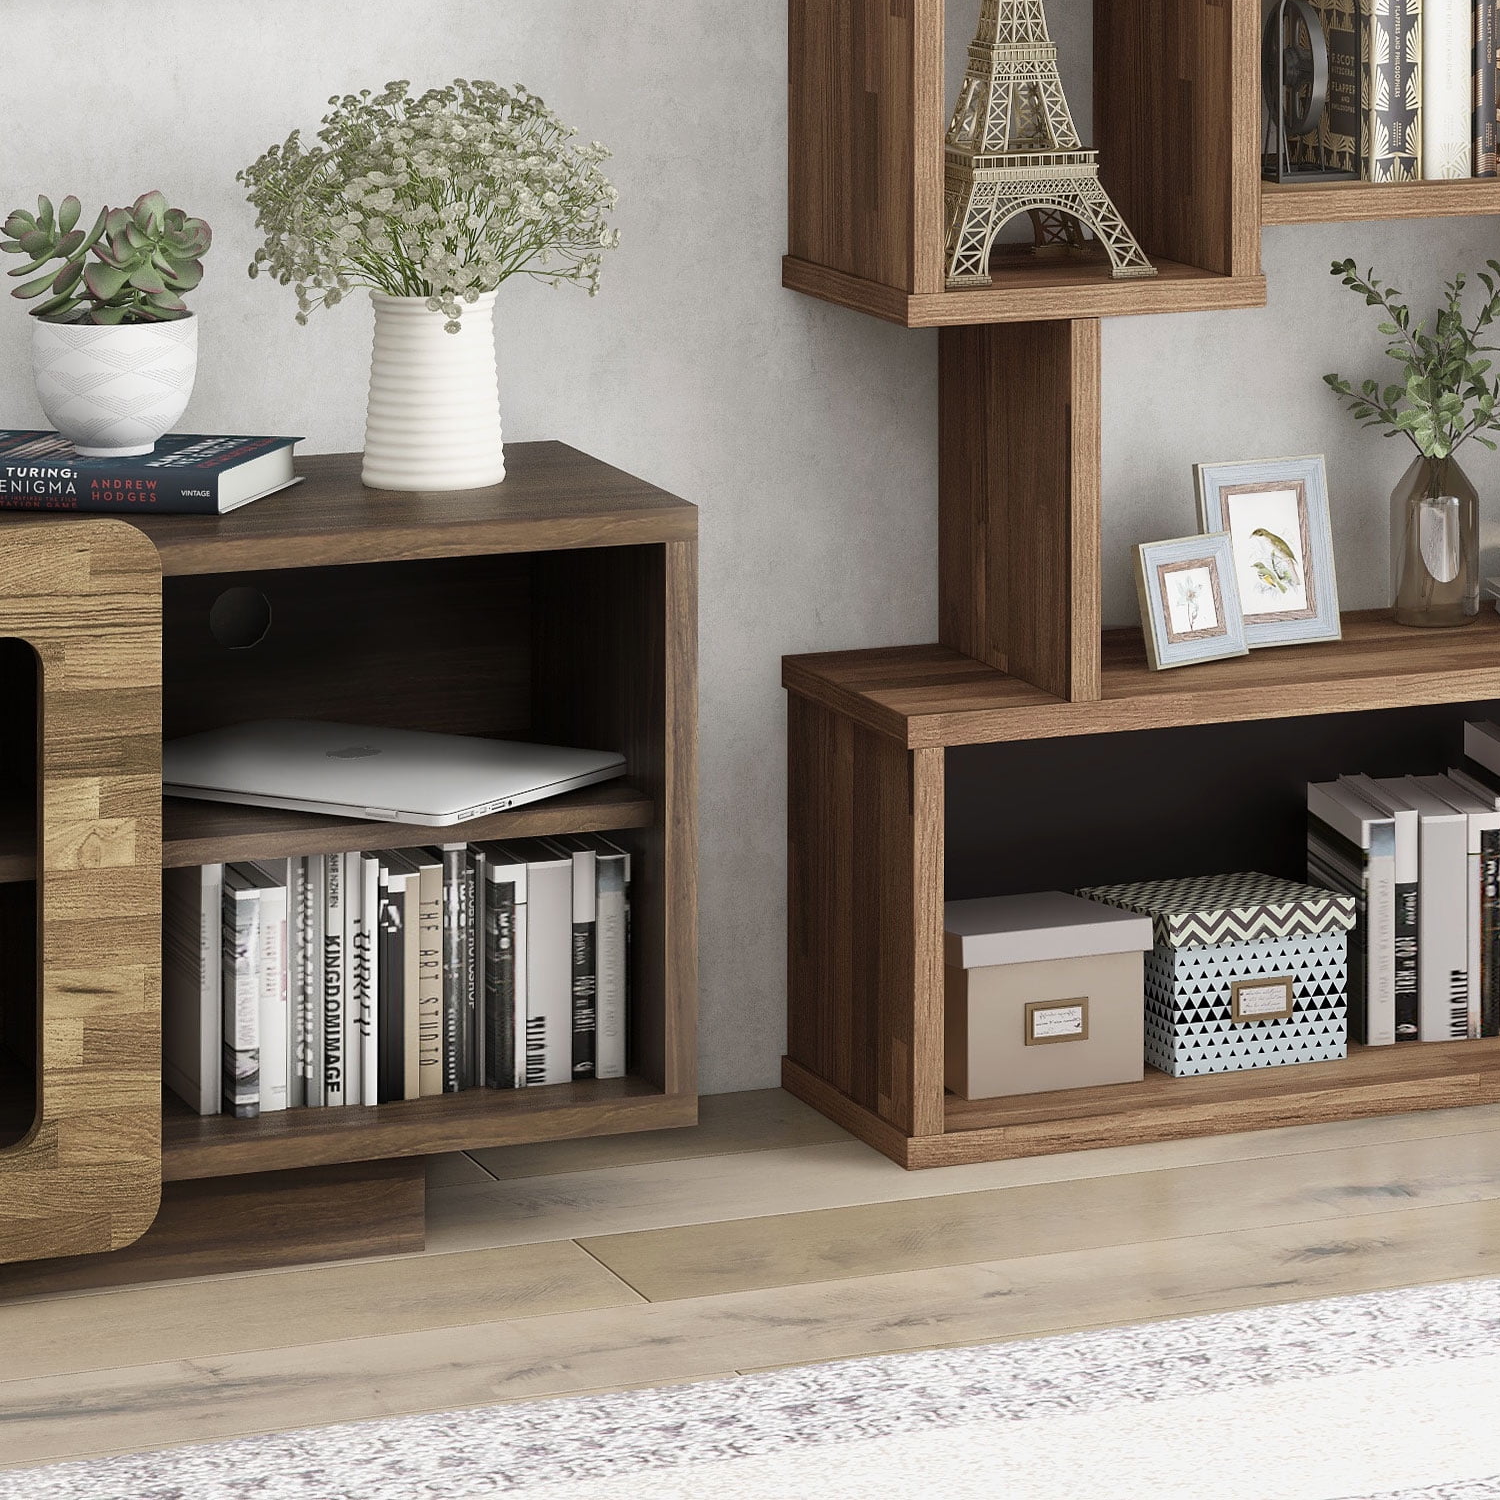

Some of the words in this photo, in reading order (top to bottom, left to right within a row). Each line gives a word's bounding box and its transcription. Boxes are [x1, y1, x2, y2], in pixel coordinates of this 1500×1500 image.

[6, 467, 78, 479] TURING:
[0, 480, 77, 494] ENIGMA
[91, 479, 158, 489] ANDREW
[92, 492, 157, 502] HODGES
